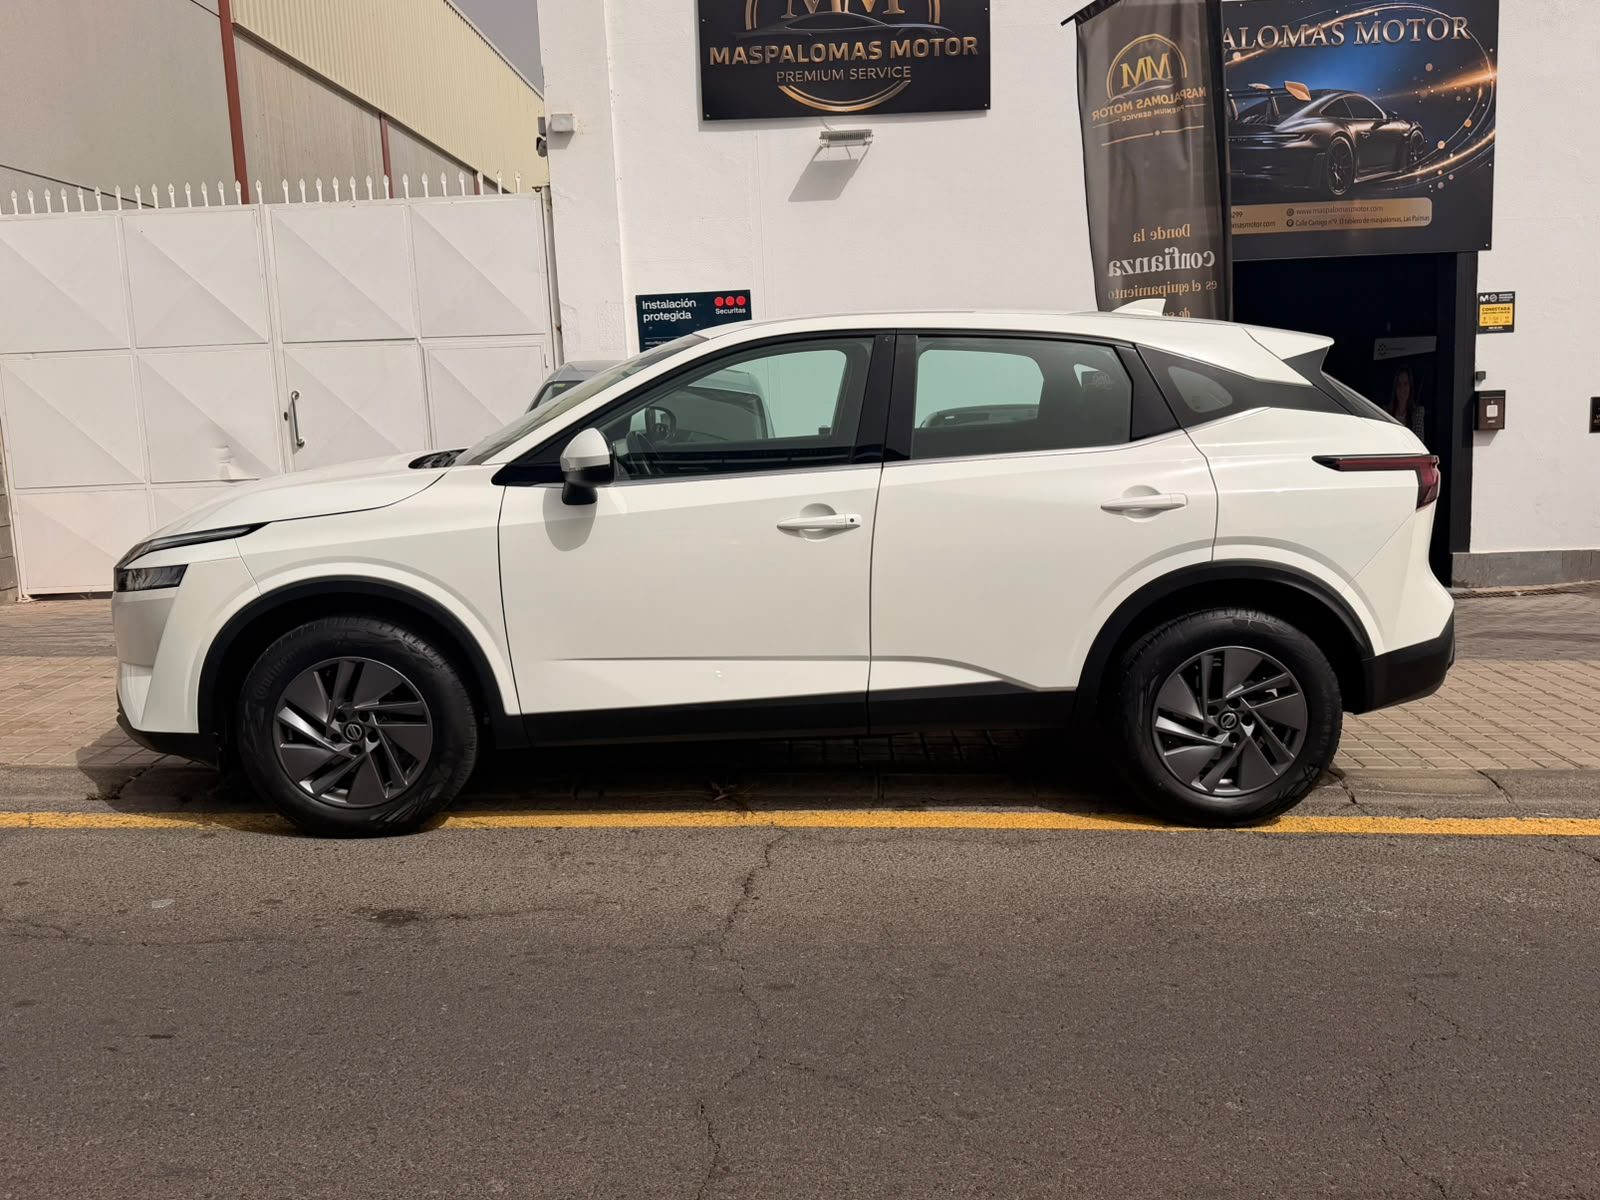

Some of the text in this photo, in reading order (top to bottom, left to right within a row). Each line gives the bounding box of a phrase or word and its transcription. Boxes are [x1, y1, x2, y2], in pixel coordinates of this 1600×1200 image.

[1353, 16, 1471, 46] MOTOR
[709, 36, 978, 65] MASPALOMAS MOTOR
[776, 66, 911, 82] PREMIUM SERVICE
[641, 298, 697, 310] Instalación
[715, 307, 746, 315] Securitas
[643, 310, 692, 323] protegida
